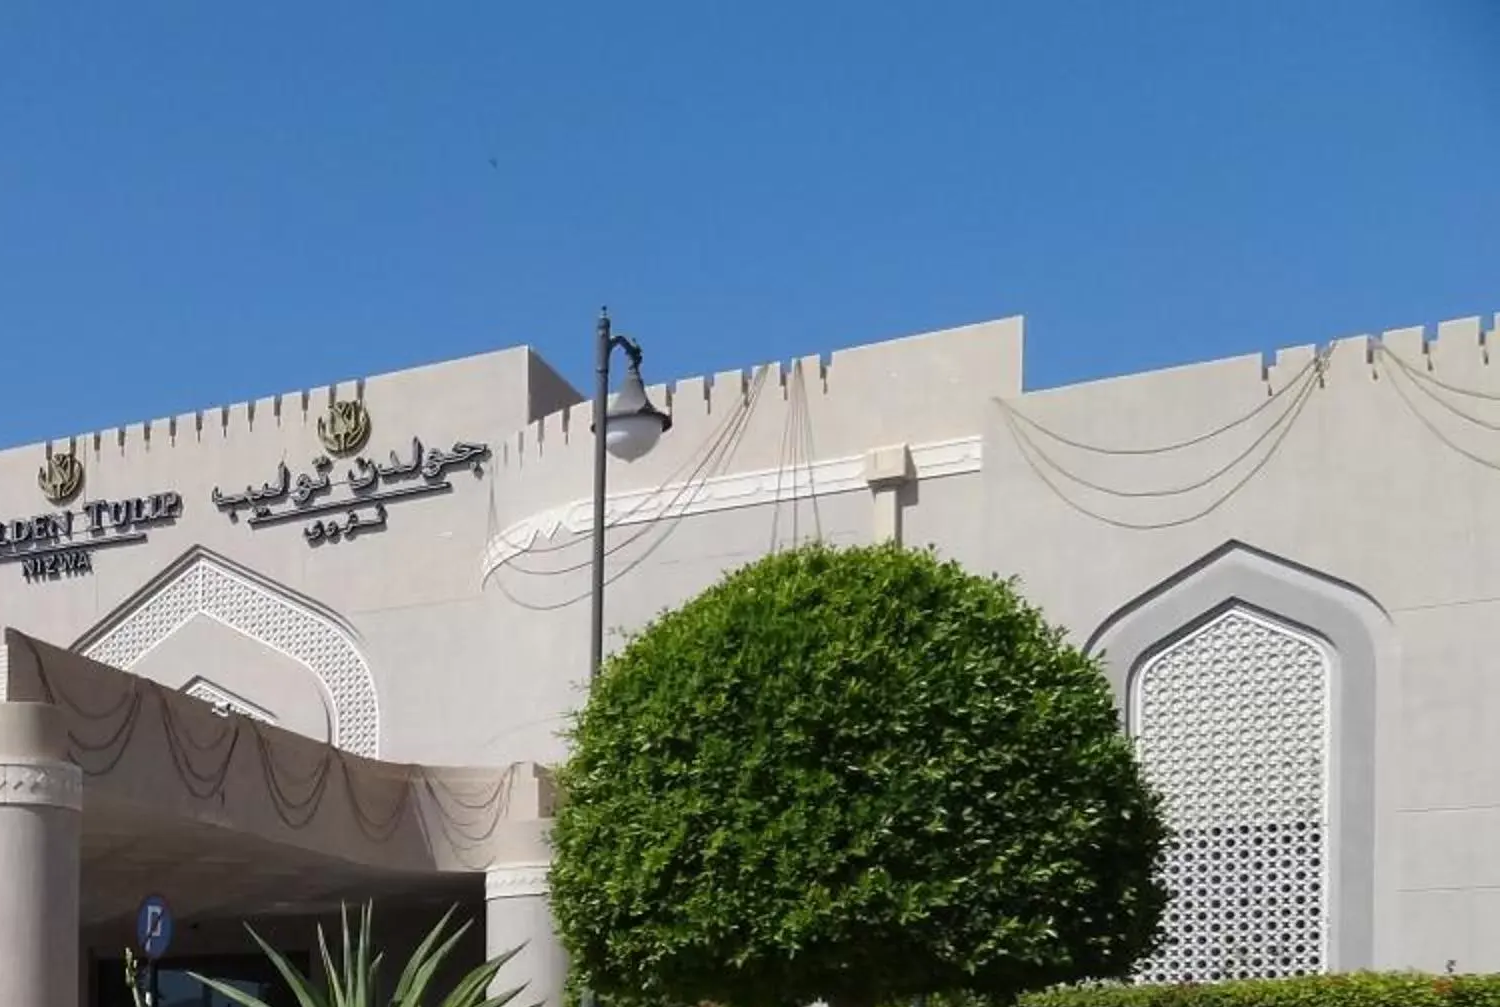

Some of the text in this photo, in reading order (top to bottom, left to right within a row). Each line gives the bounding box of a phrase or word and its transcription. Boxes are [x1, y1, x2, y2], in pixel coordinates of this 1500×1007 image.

[211, 436, 492, 524] جولدن توليب
[83, 492, 183, 532] TULIP
[22, 551, 93, 581] NIZWA
